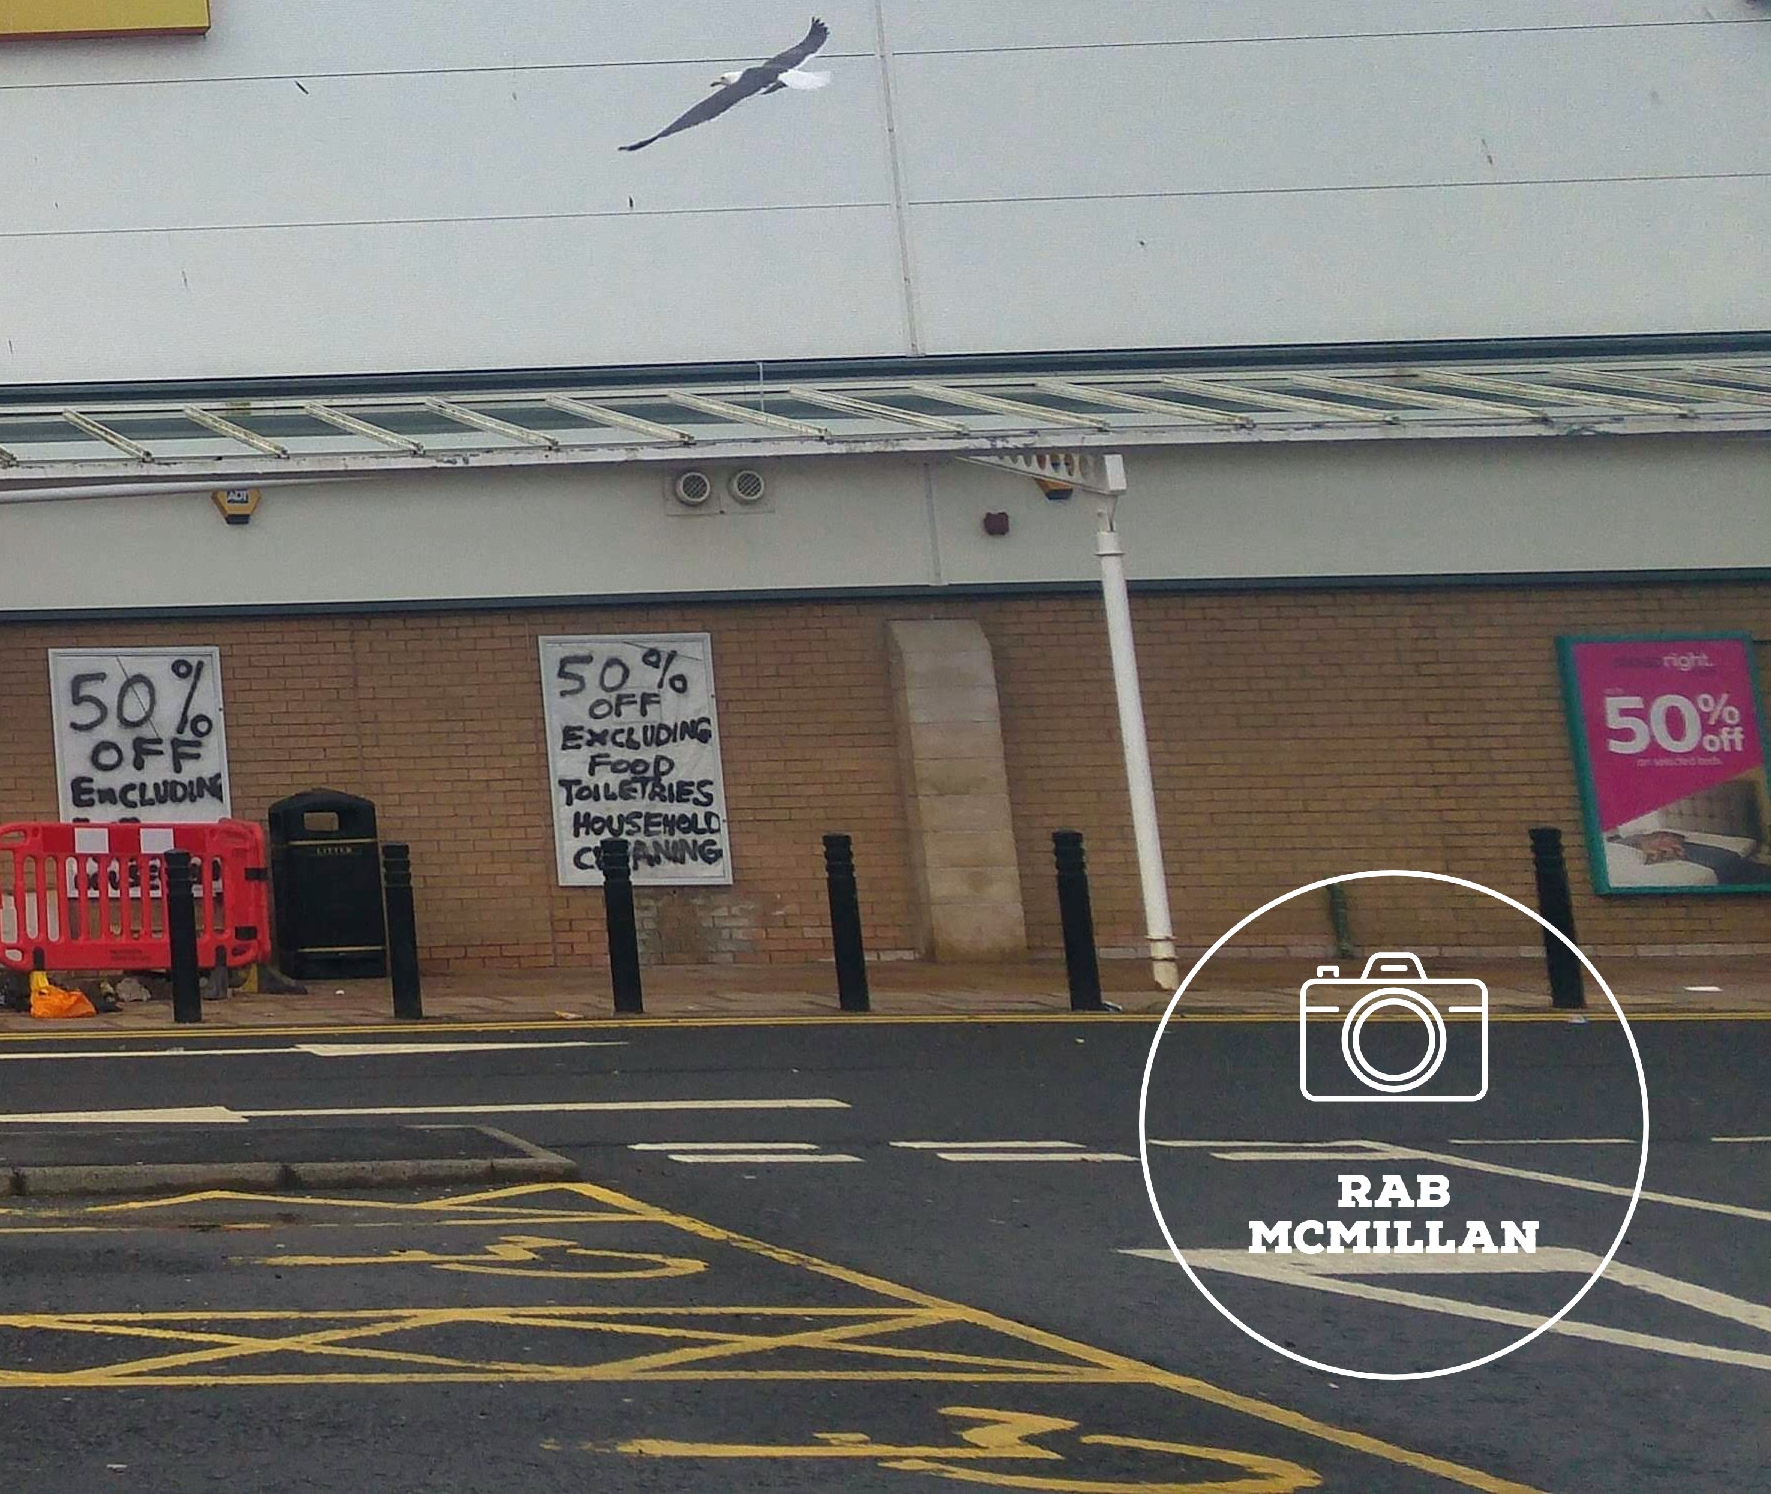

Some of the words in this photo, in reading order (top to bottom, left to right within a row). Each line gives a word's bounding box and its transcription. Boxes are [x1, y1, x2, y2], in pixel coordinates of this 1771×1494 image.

[558, 649, 689, 696] 50%
[69, 658, 213, 738] 50%
[589, 692, 662, 720] OFF
[90, 736, 203, 774] OFF
[1702, 726, 1746, 754] off
[558, 777, 715, 807] TOILETRIES
[572, 809, 721, 838] HOUSEHOLD
